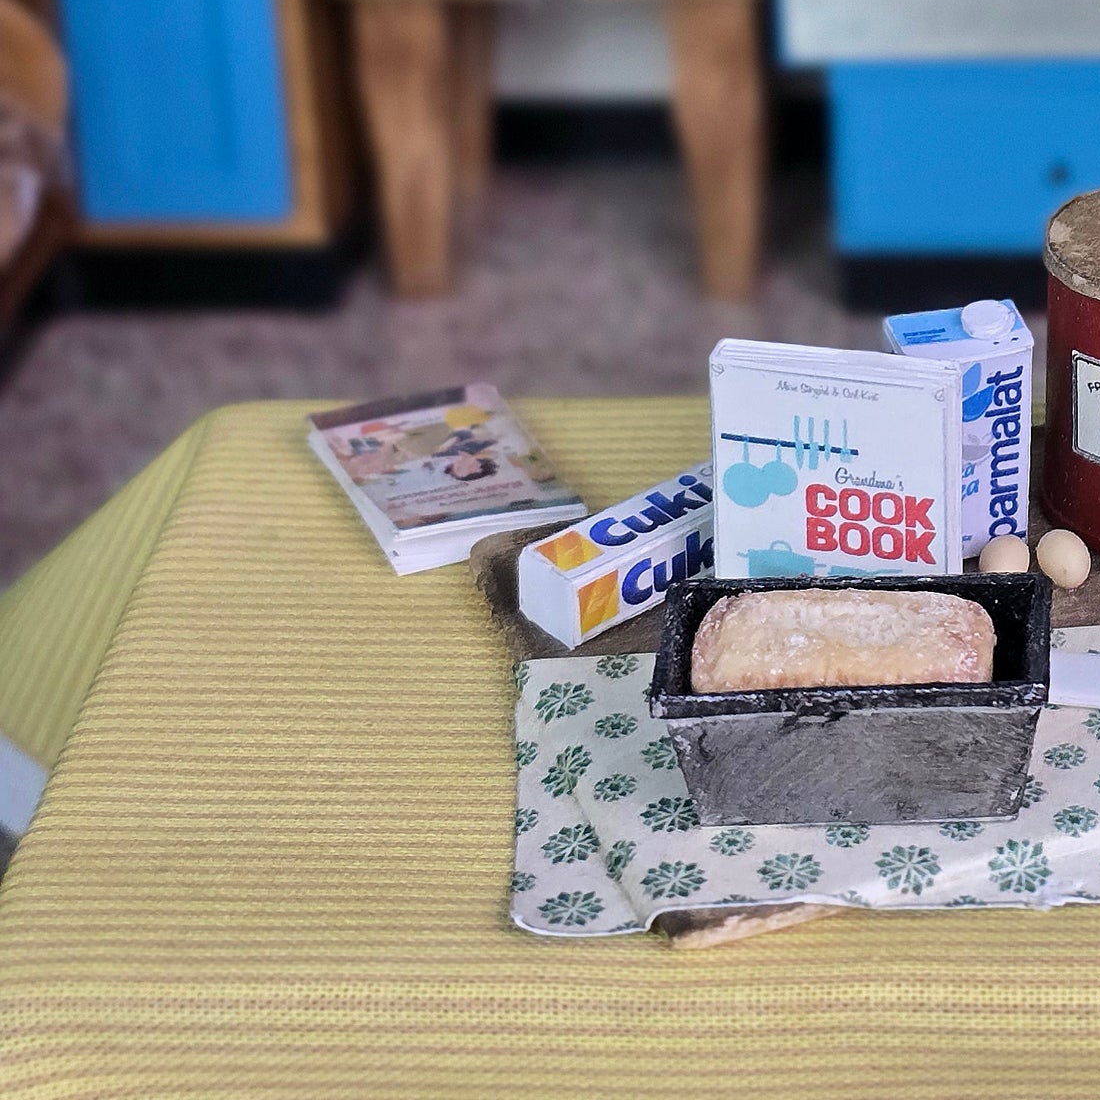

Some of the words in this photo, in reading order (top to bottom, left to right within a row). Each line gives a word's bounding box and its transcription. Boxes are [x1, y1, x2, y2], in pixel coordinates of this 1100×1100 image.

[984, 365, 1027, 541] parmalat
[589, 475, 713, 546] Cuki
[806, 484, 935, 530] COOK
[806, 517, 936, 565] BOOK
[621, 530, 714, 606] Cuk
